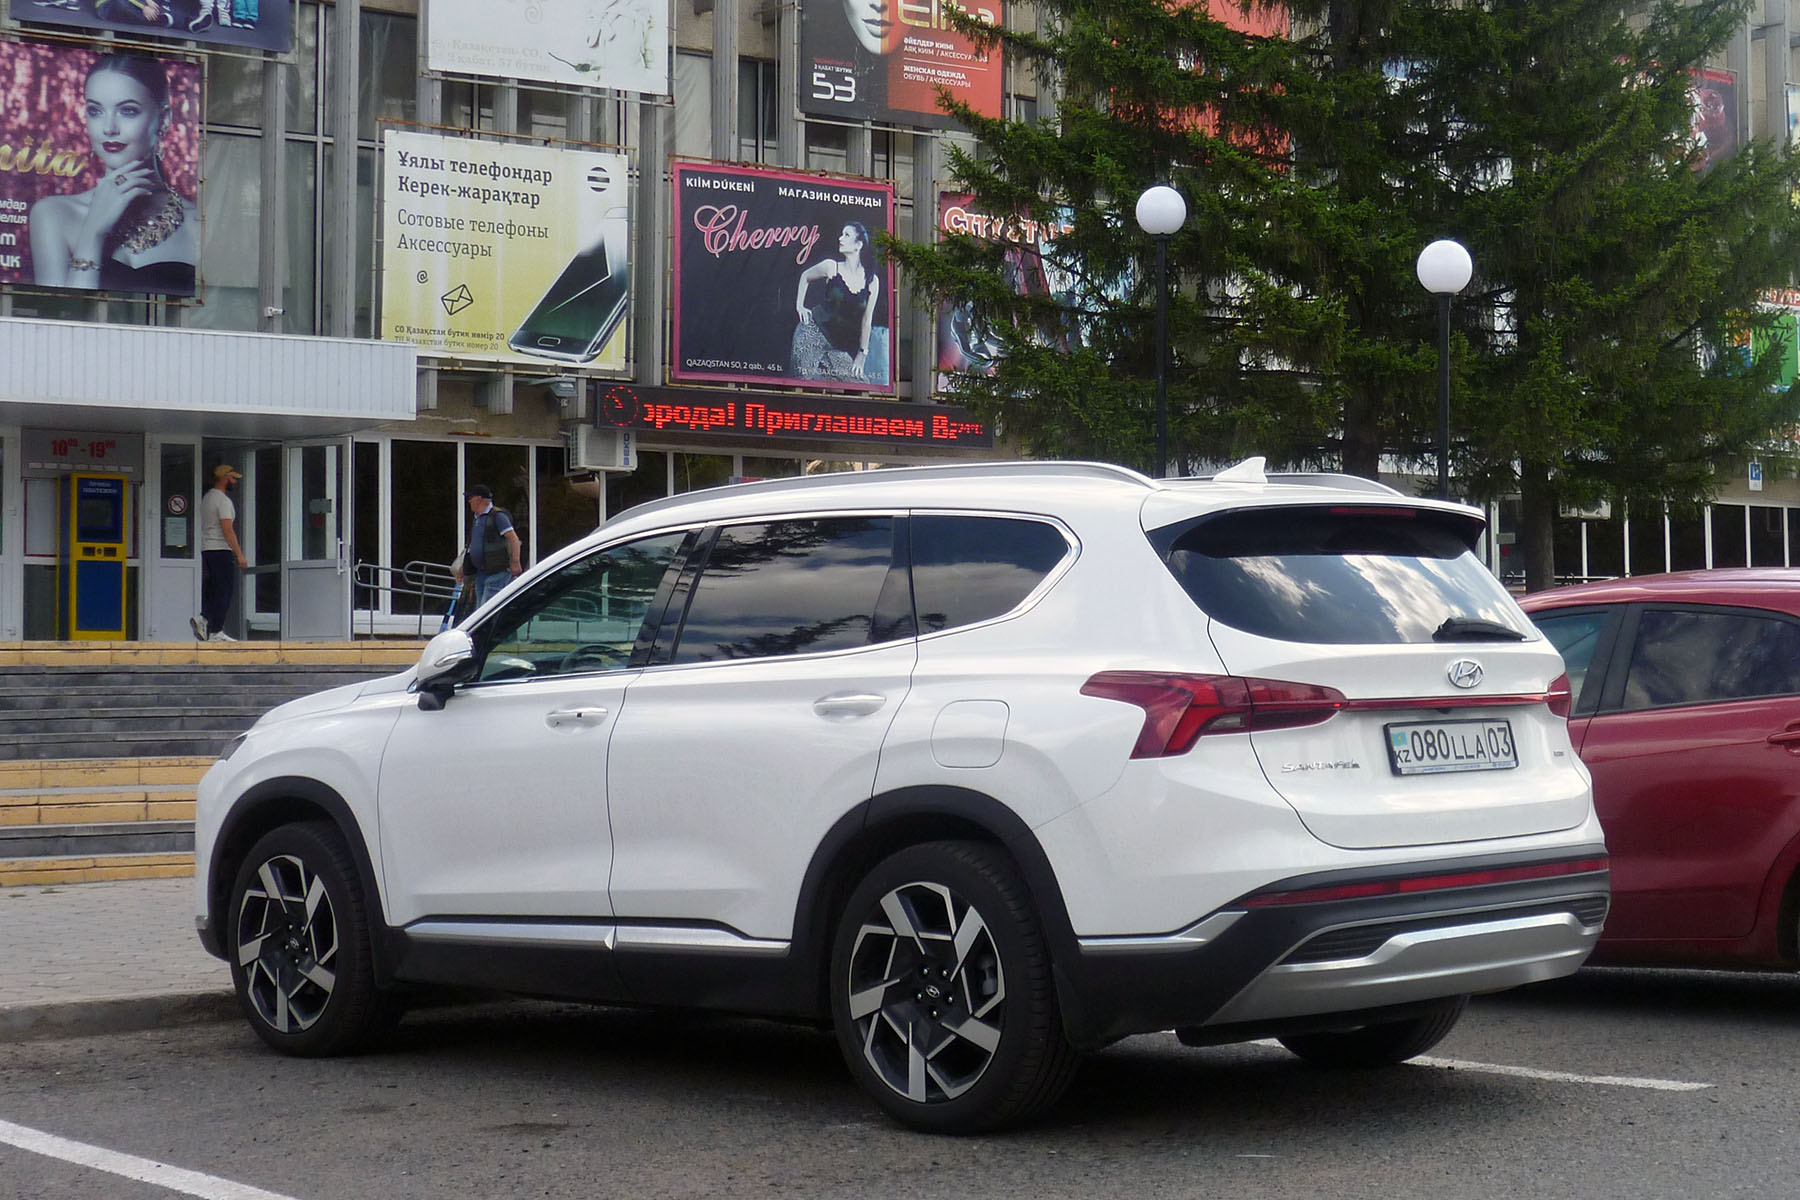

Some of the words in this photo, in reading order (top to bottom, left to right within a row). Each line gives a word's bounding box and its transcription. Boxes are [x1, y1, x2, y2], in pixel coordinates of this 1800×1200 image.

[903, 65, 936, 75] ЖЕНСКАЯ
[903, 73, 925, 82] ОБУВЬ
[812, 72, 856, 103] 53
[397, 151, 445, 171] Ұялы
[450, 159, 552, 186] телефондар
[398, 176, 541, 208] Керек-жарақтар
[778, 186, 831, 202] МАГАЗИН
[833, 194, 882, 208] ОДЕЖДЫ
[397, 208, 465, 232] Сотовые
[469, 218, 549, 240] телефоны
[693, 205, 820, 264] Cherry
[397, 233, 492, 259] Аксессуары
[496, 332, 505, 341] 20
[686, 358, 730, 368] QAZAQSTAN
[767, 363, 776, 371] 45
[745, 402, 924, 439] Приглашаем
[1394, 750, 1412, 764] KZ
